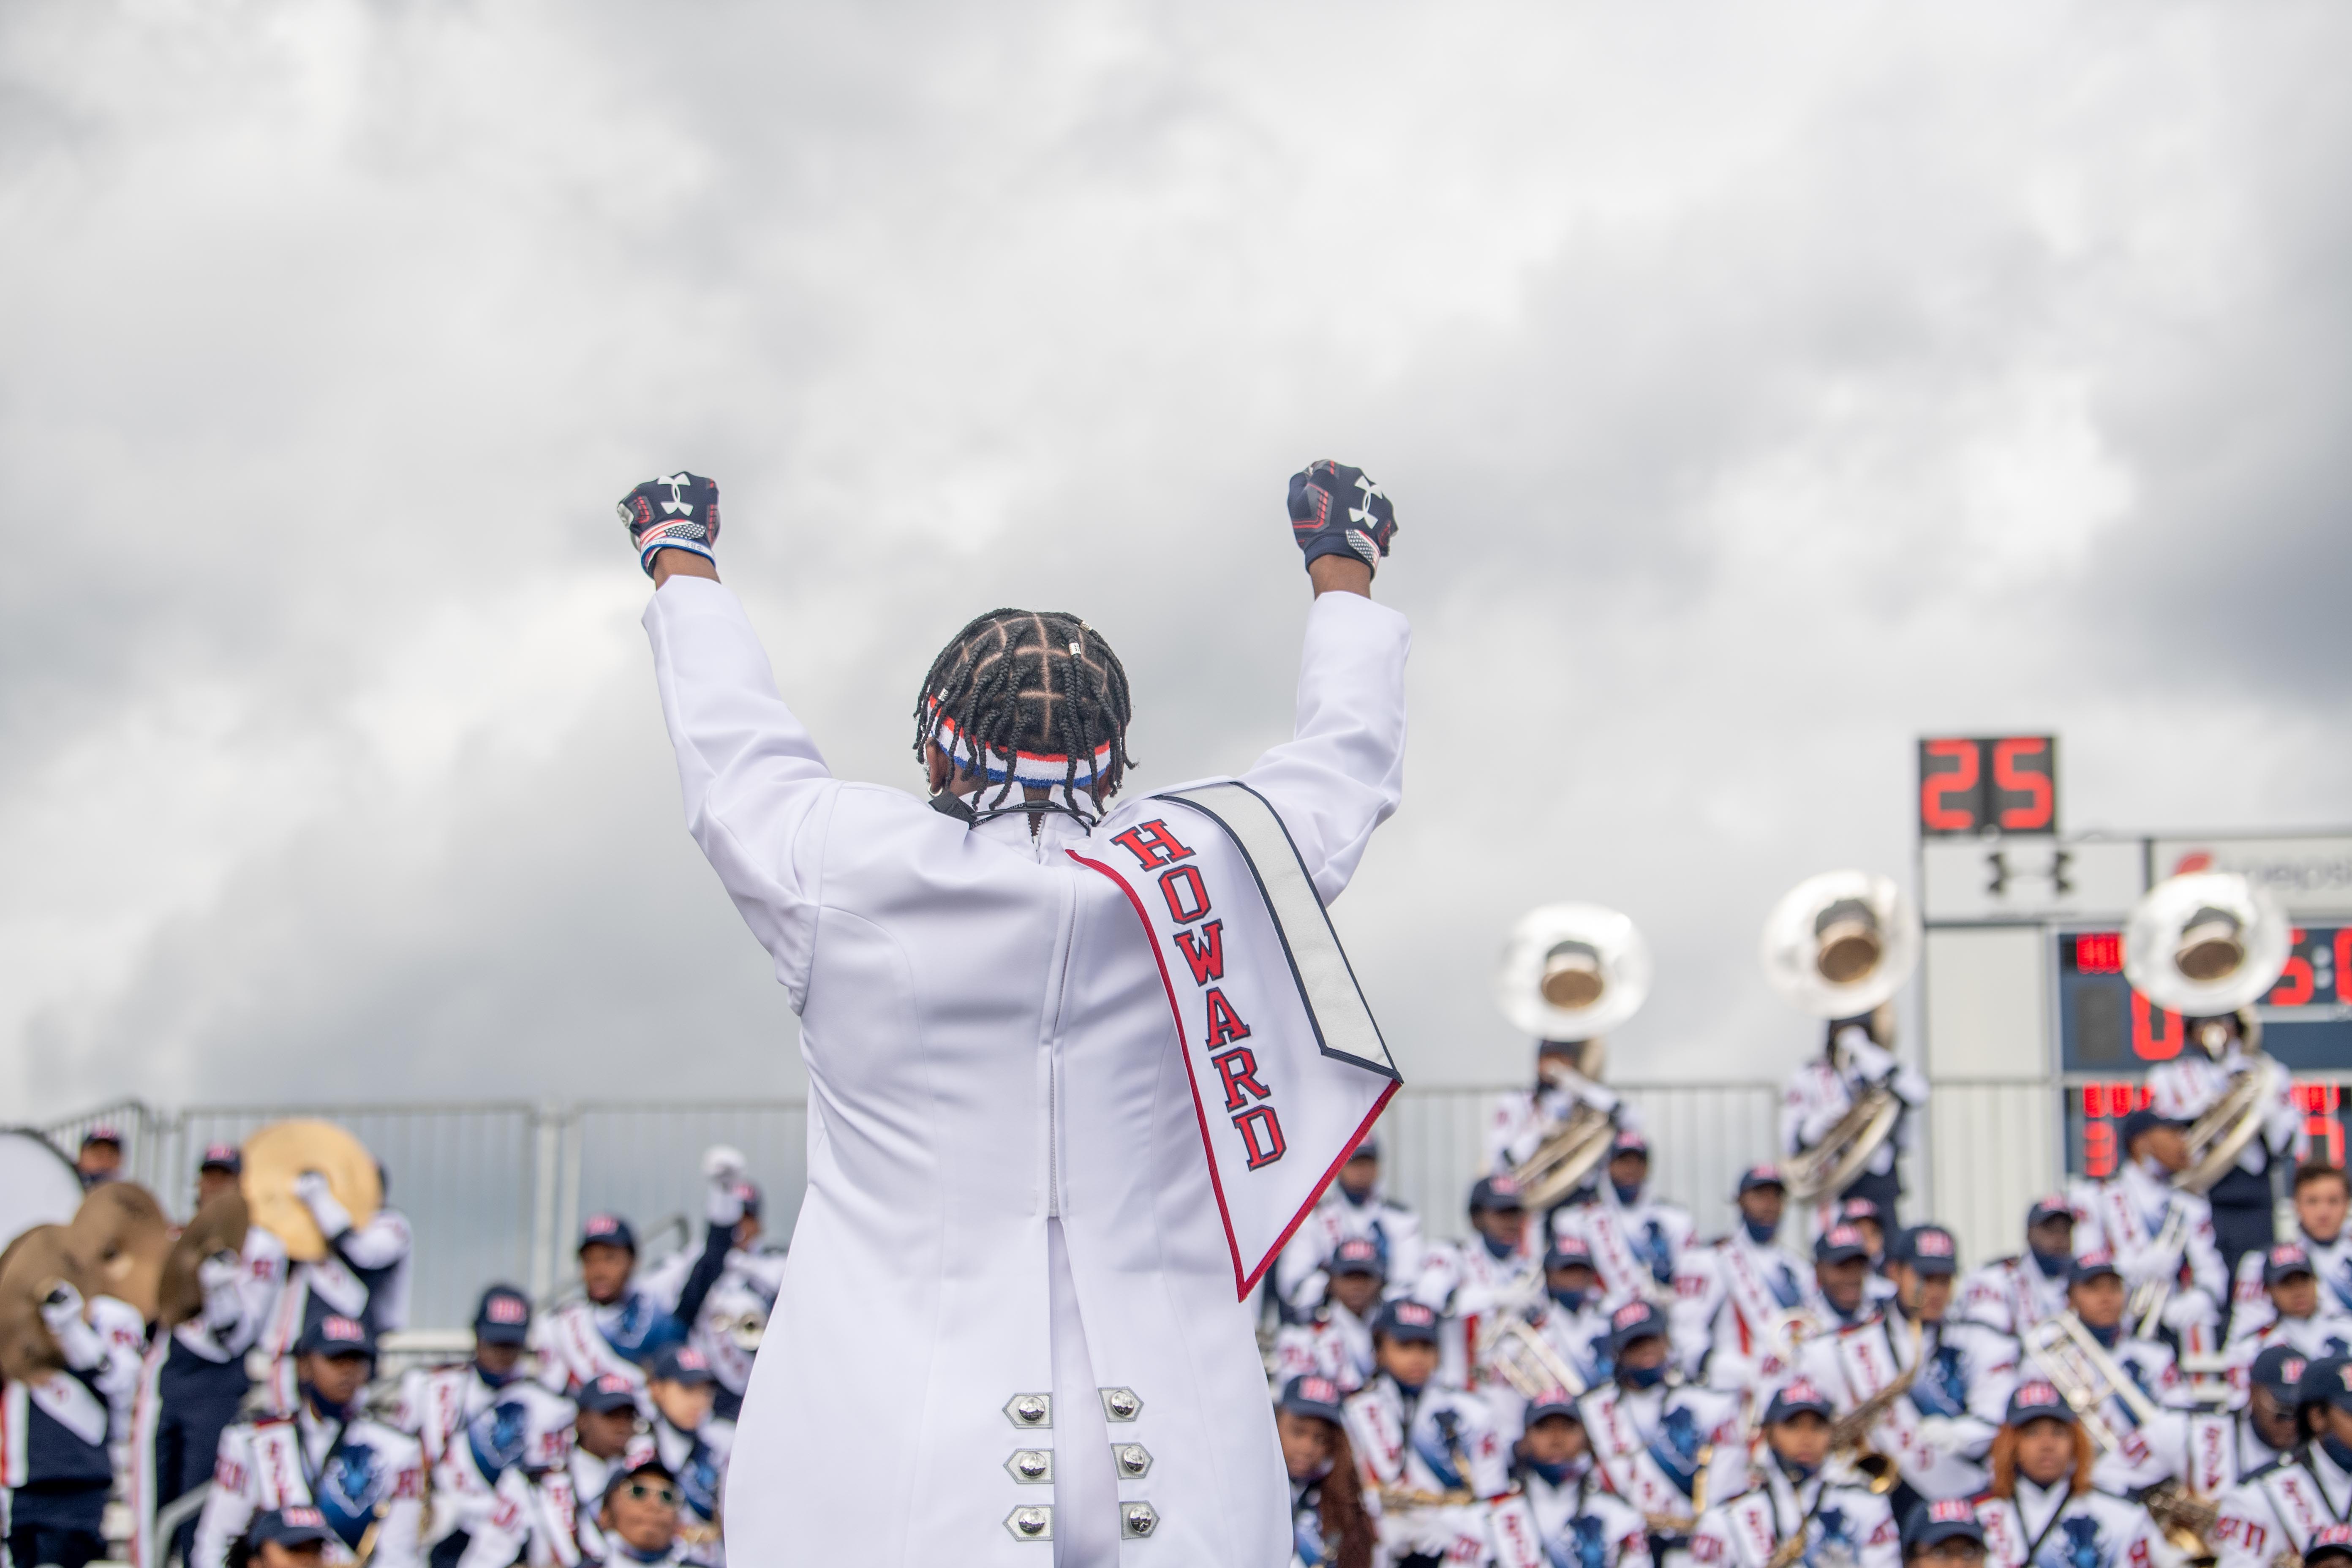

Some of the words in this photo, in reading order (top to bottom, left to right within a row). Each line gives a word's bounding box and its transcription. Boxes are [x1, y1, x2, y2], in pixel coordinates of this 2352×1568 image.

[969, 818, 987, 829] OX40
[1921, 736, 2053, 829] 25
[1110, 818, 1286, 1172] HOWARD
